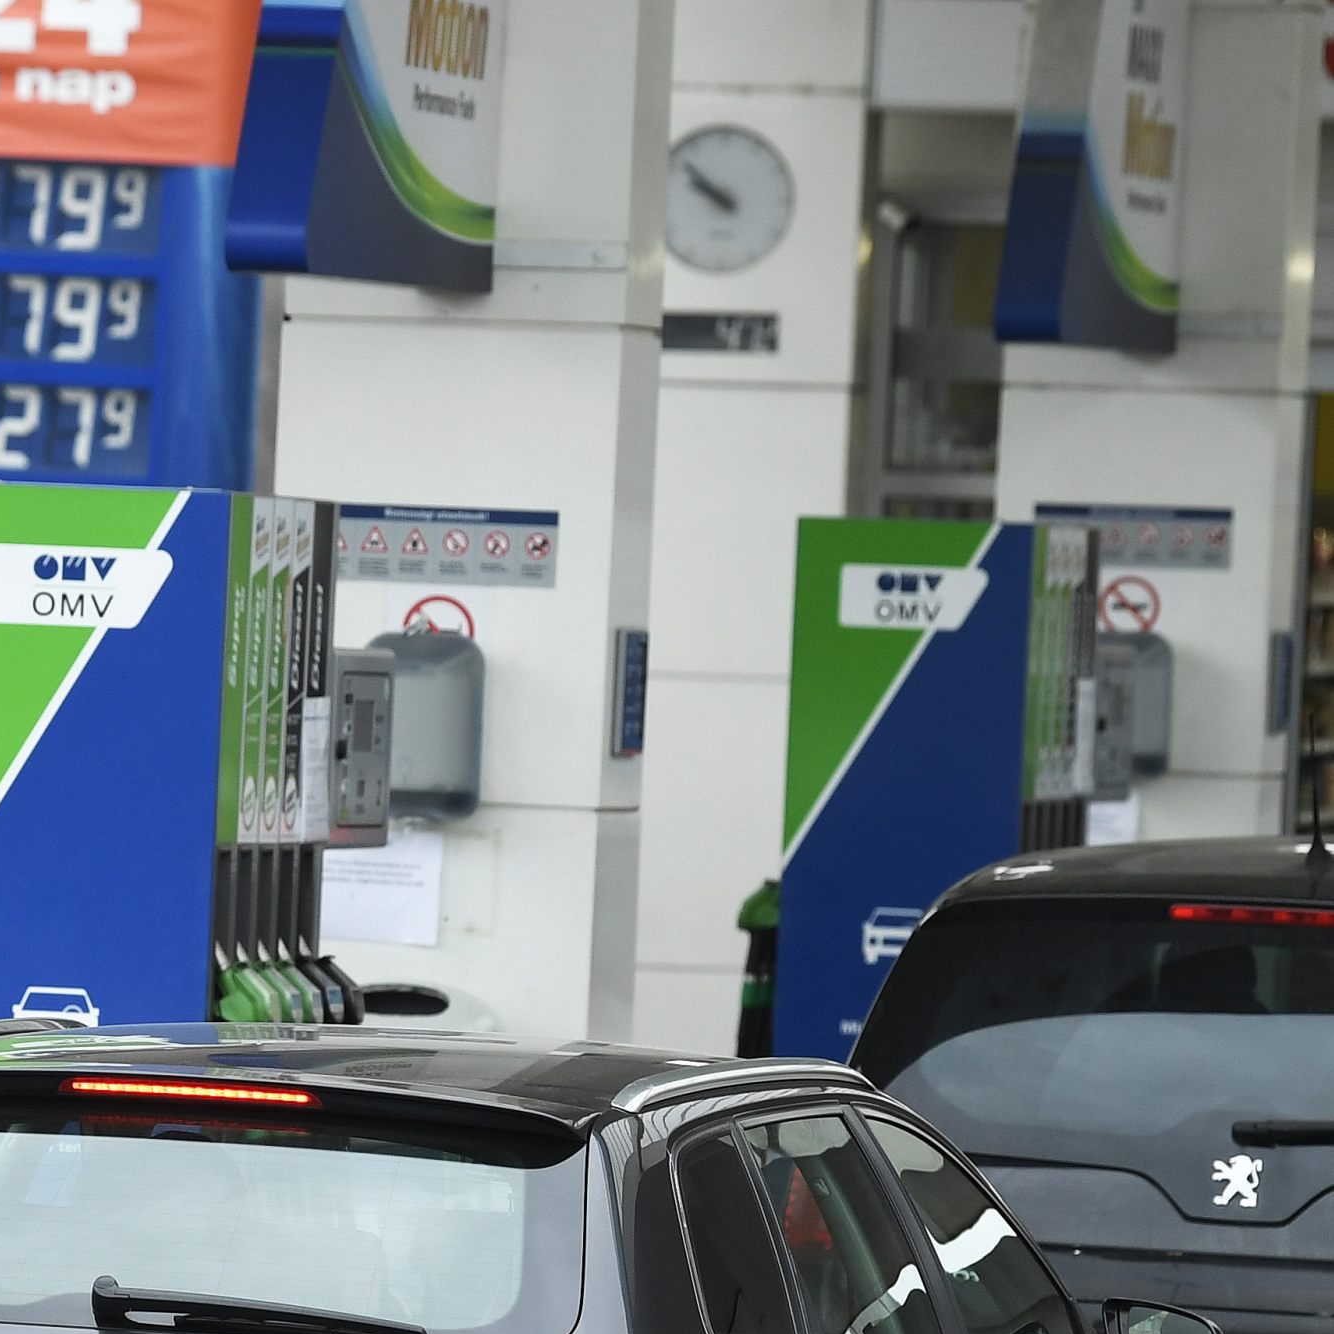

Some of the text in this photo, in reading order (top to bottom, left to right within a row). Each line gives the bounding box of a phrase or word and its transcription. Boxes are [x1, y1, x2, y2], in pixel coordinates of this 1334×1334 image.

[13, 68, 137, 114] nap
[32, 591, 114, 618] OMV
[875, 599, 941, 625] OMV
